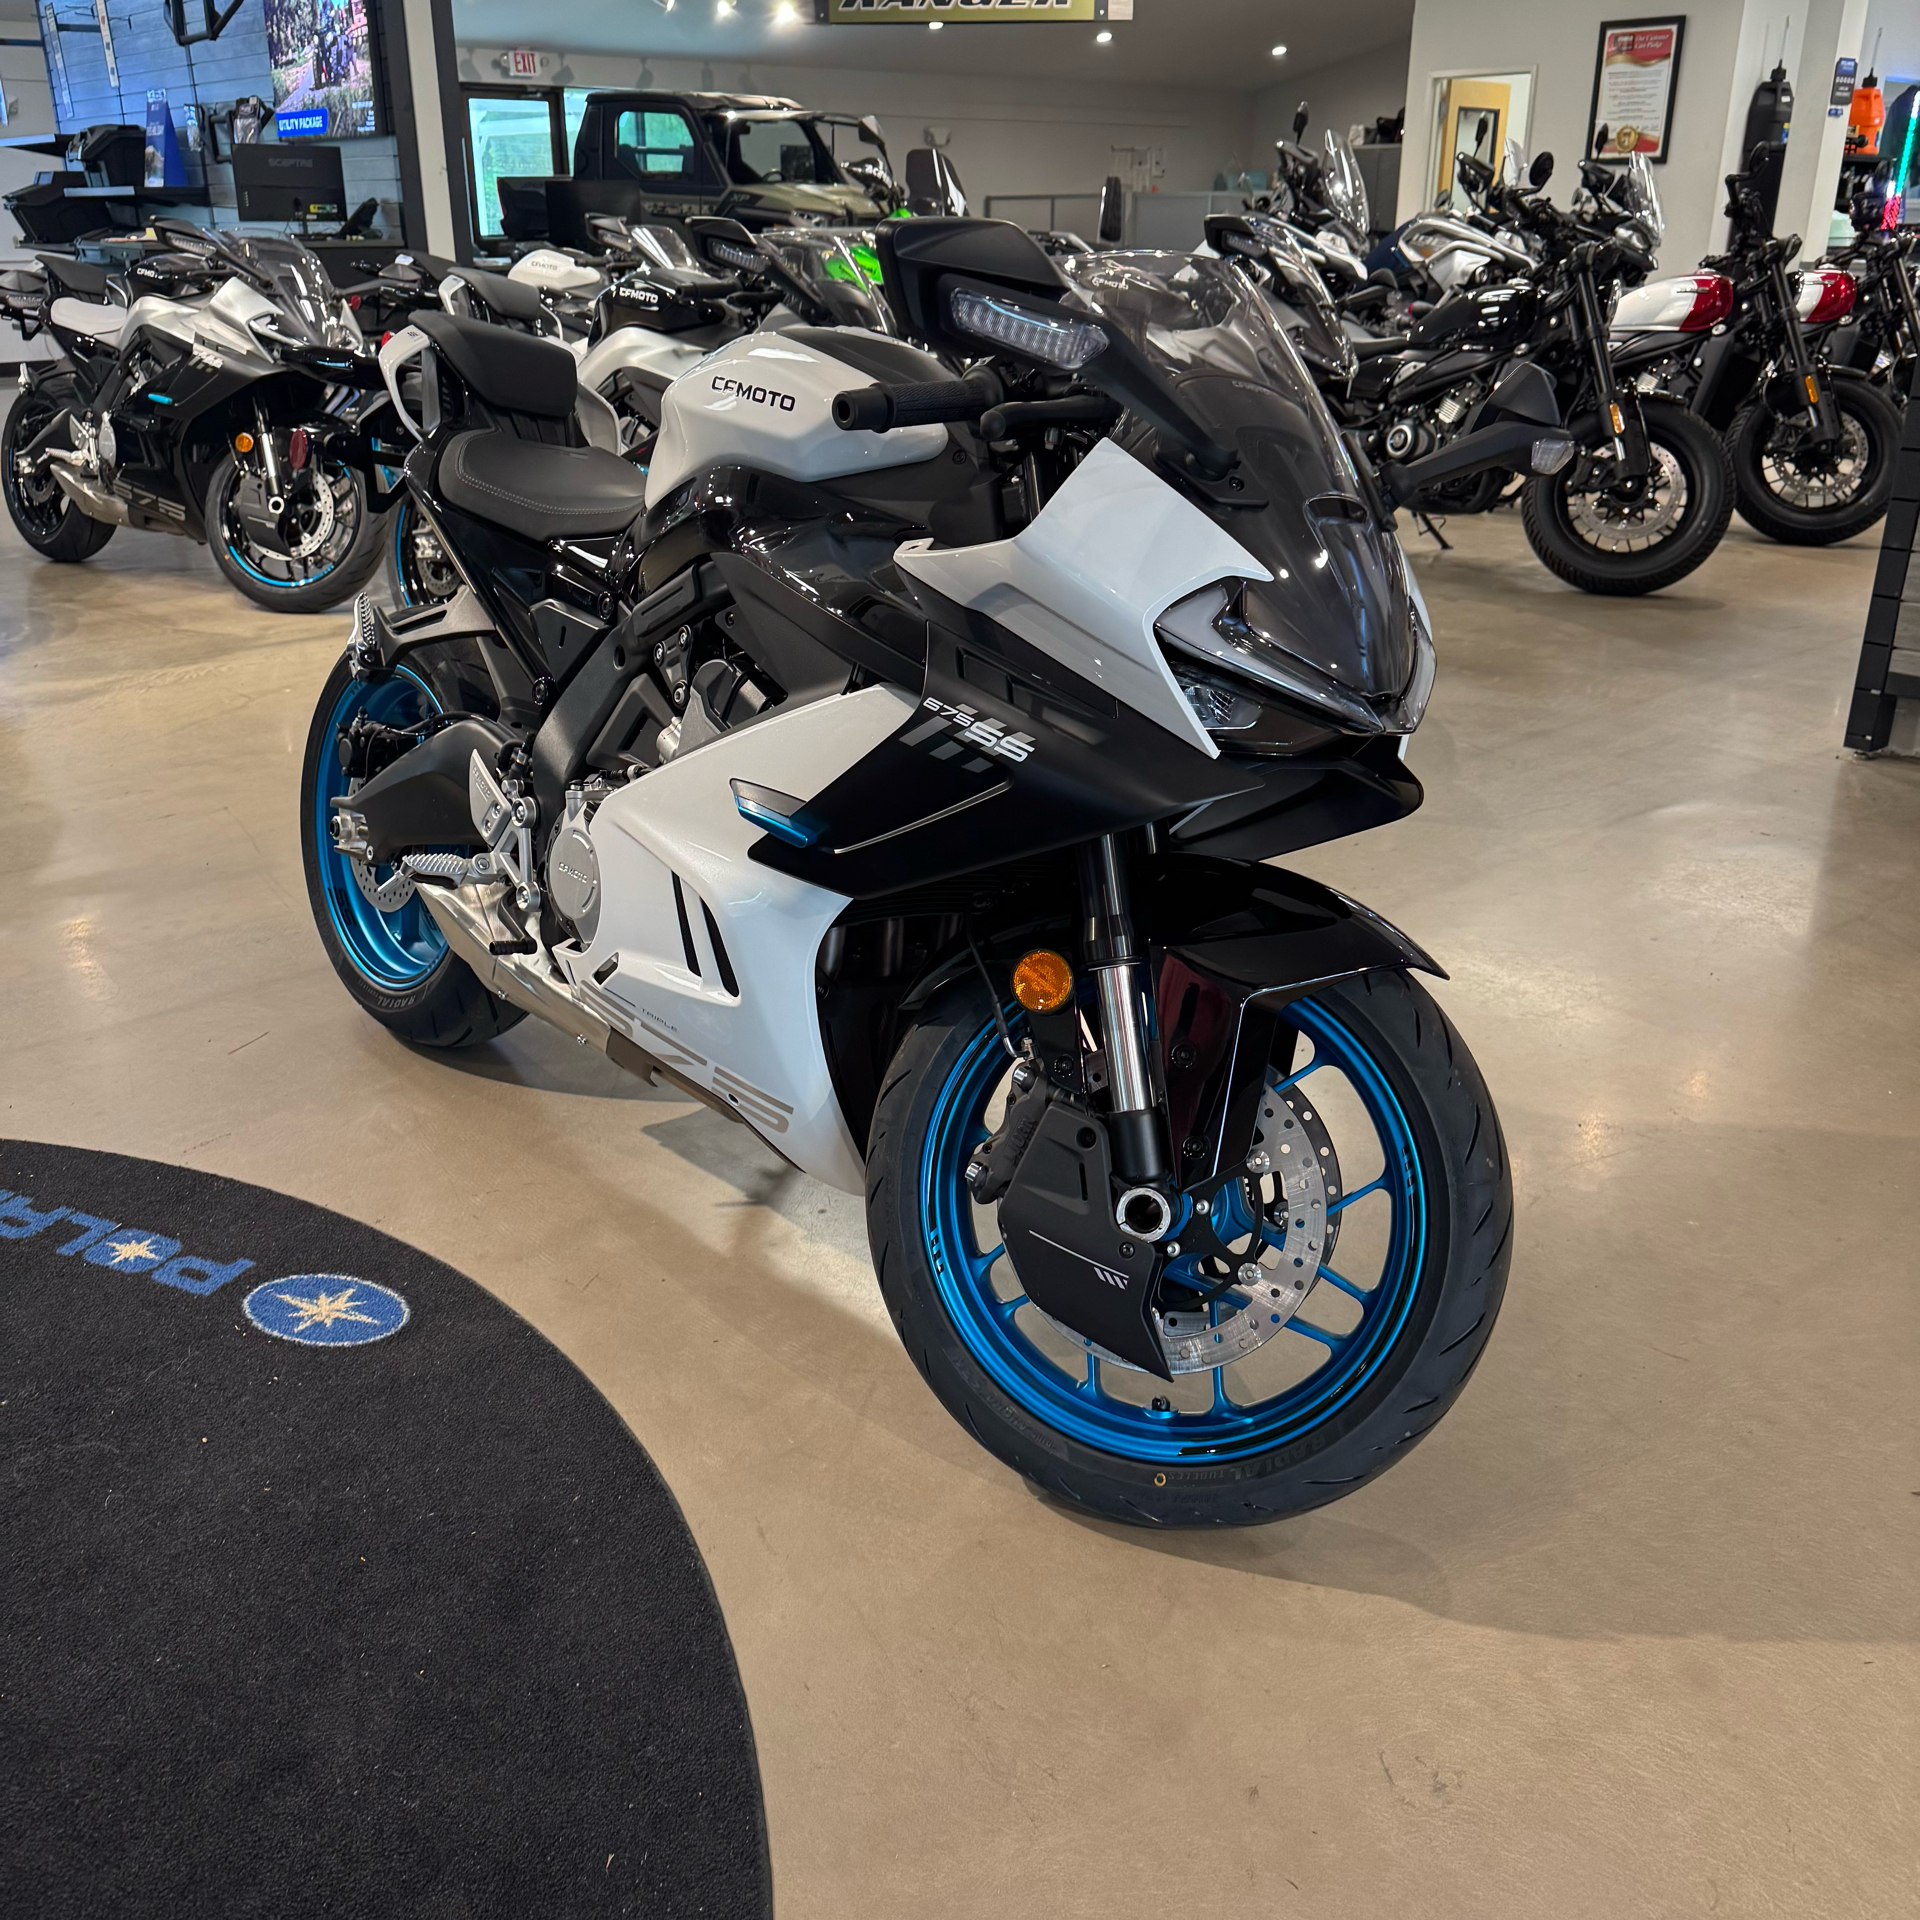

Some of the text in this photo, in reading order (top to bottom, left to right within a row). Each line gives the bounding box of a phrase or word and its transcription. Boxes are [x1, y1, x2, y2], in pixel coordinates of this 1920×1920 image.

[513, 52, 536, 73] EXIT
[278, 116, 323, 131] UTILITY PACKAGE
[619, 286, 659, 304] CFMOTO
[711, 375, 796, 412] CFMOTO
[923, 696, 1036, 763] 675 SS
[377, 994, 417, 1009] RADIAL
[642, 1007, 679, 1032] TRIPLE
[0, 1189, 256, 1296] POLA
[1161, 1432, 1327, 1481] RADIAL TUBELES
